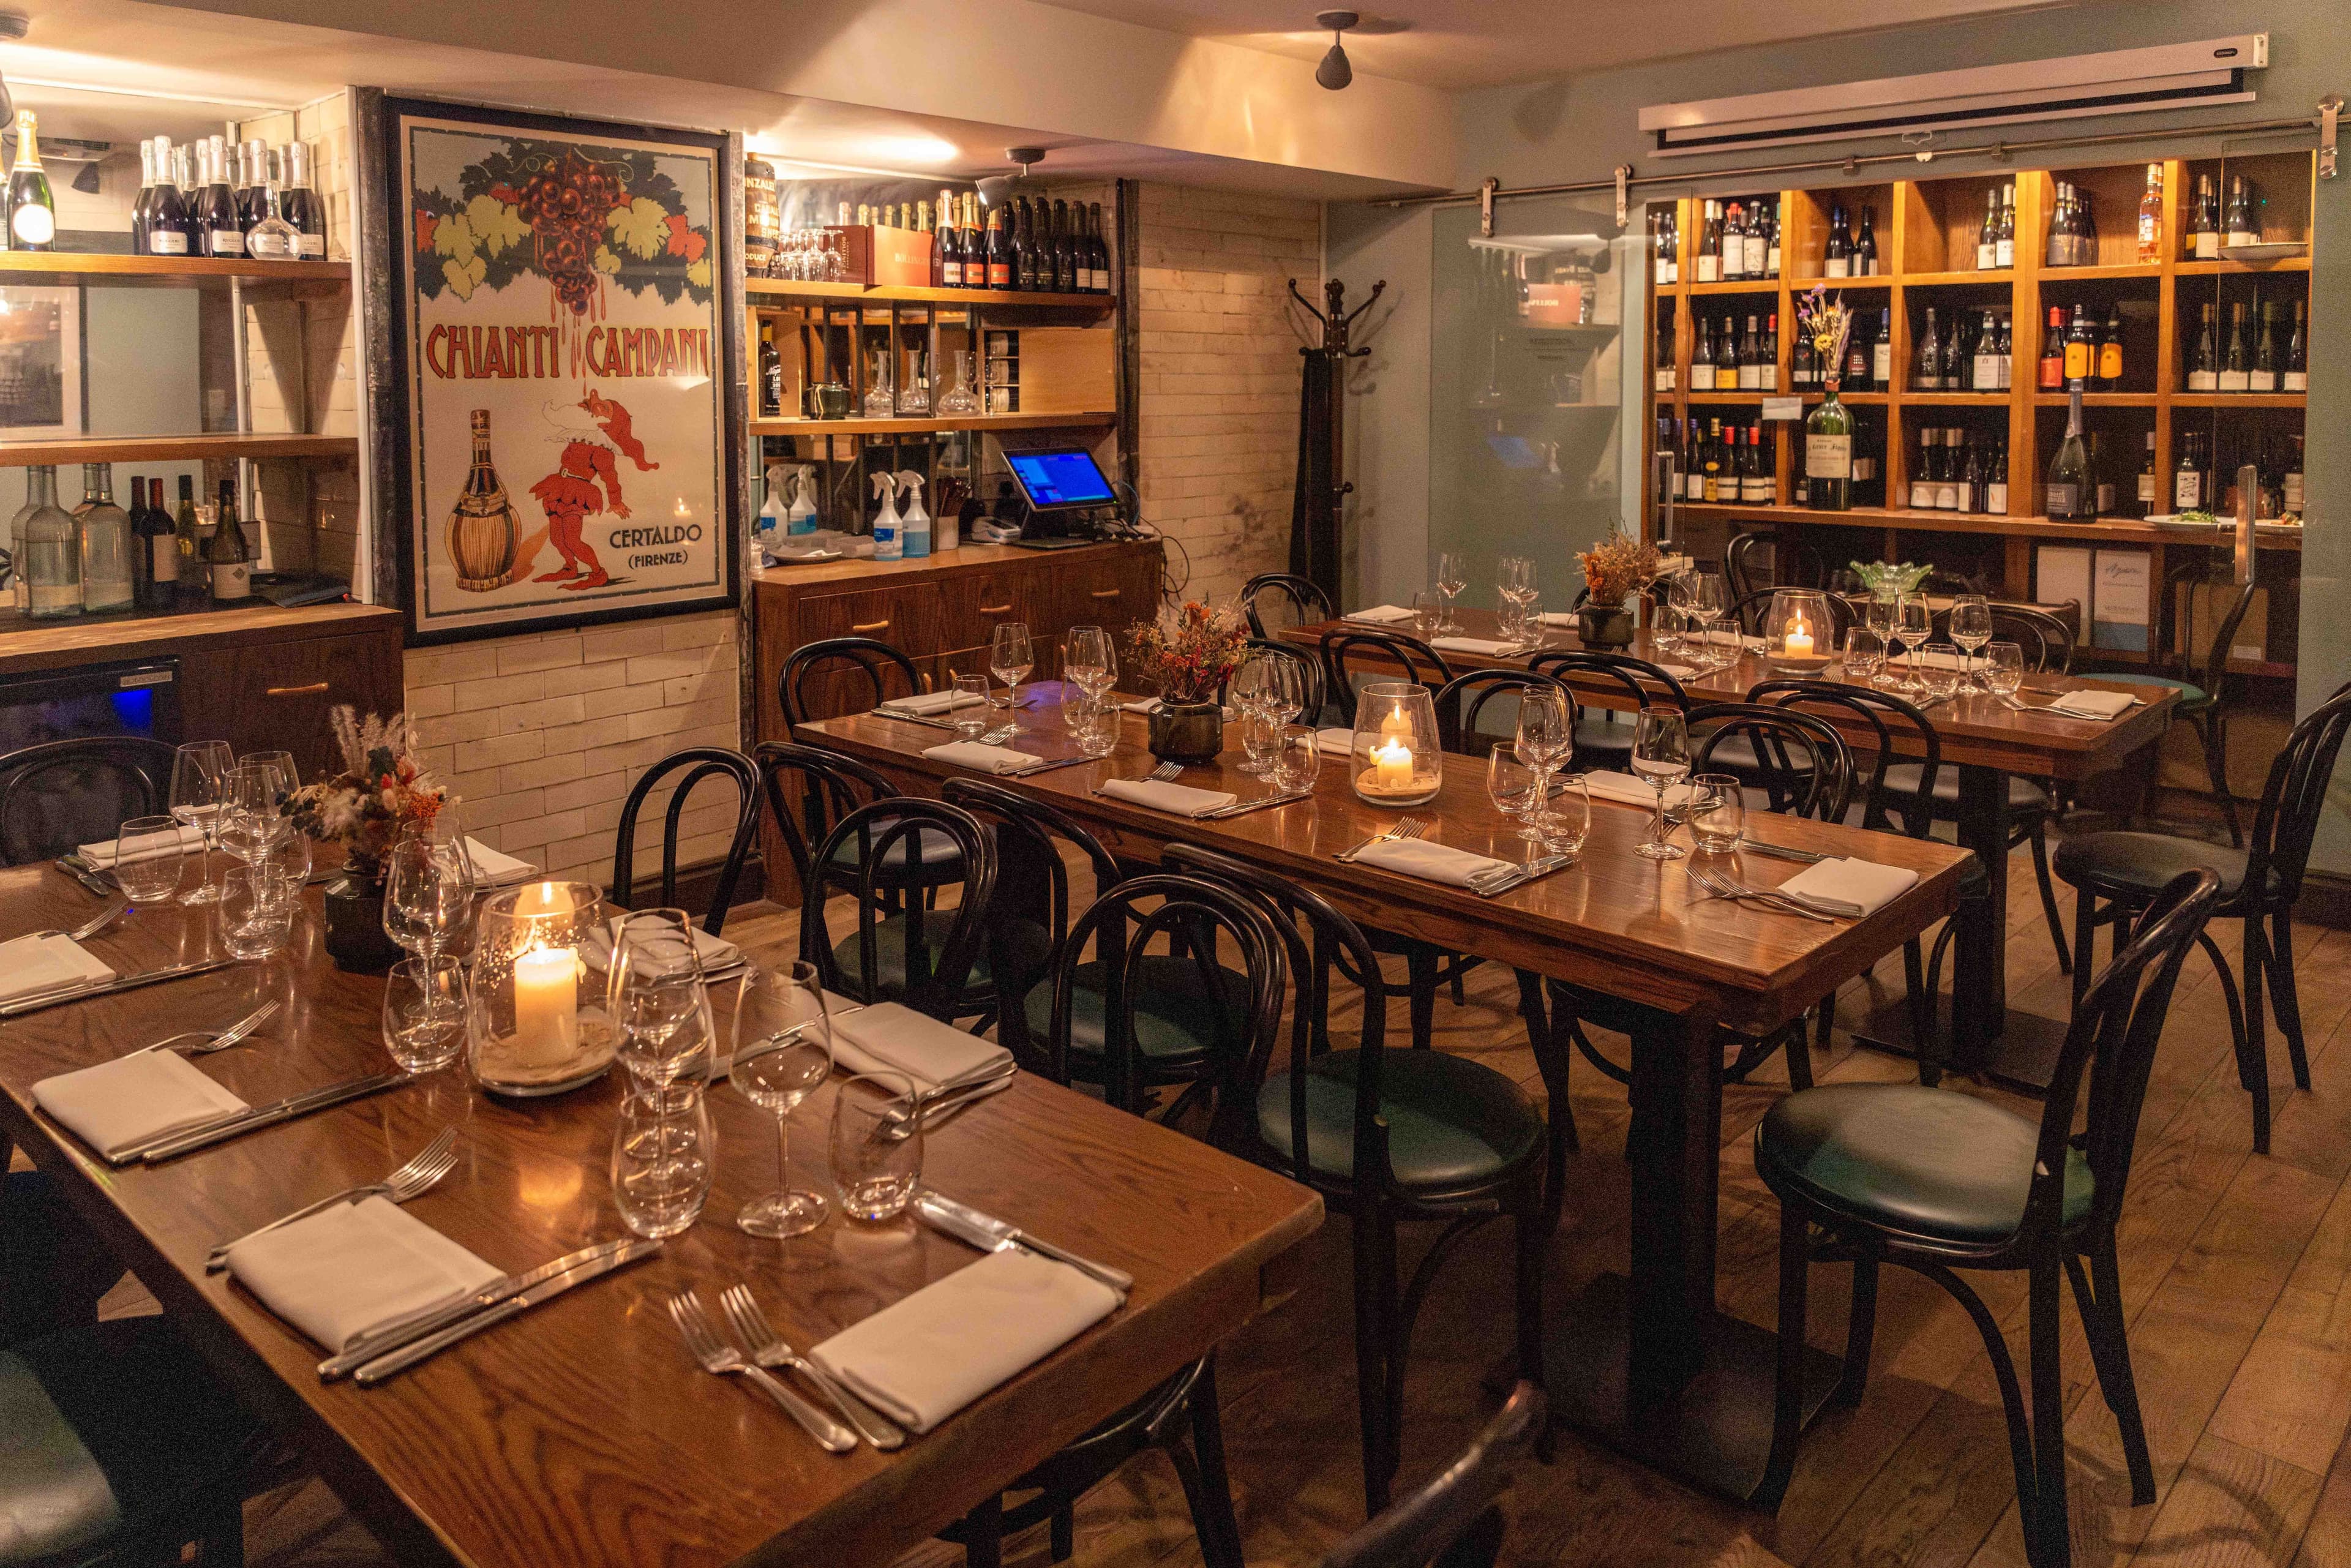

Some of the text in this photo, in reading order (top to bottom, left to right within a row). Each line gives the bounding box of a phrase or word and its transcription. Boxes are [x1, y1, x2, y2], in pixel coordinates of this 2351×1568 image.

[426, 324, 709, 379] CHIANTI CAMPANI
[609, 523, 702, 549] CERTALDO
[628, 549, 688, 569] (FIRENZE)
